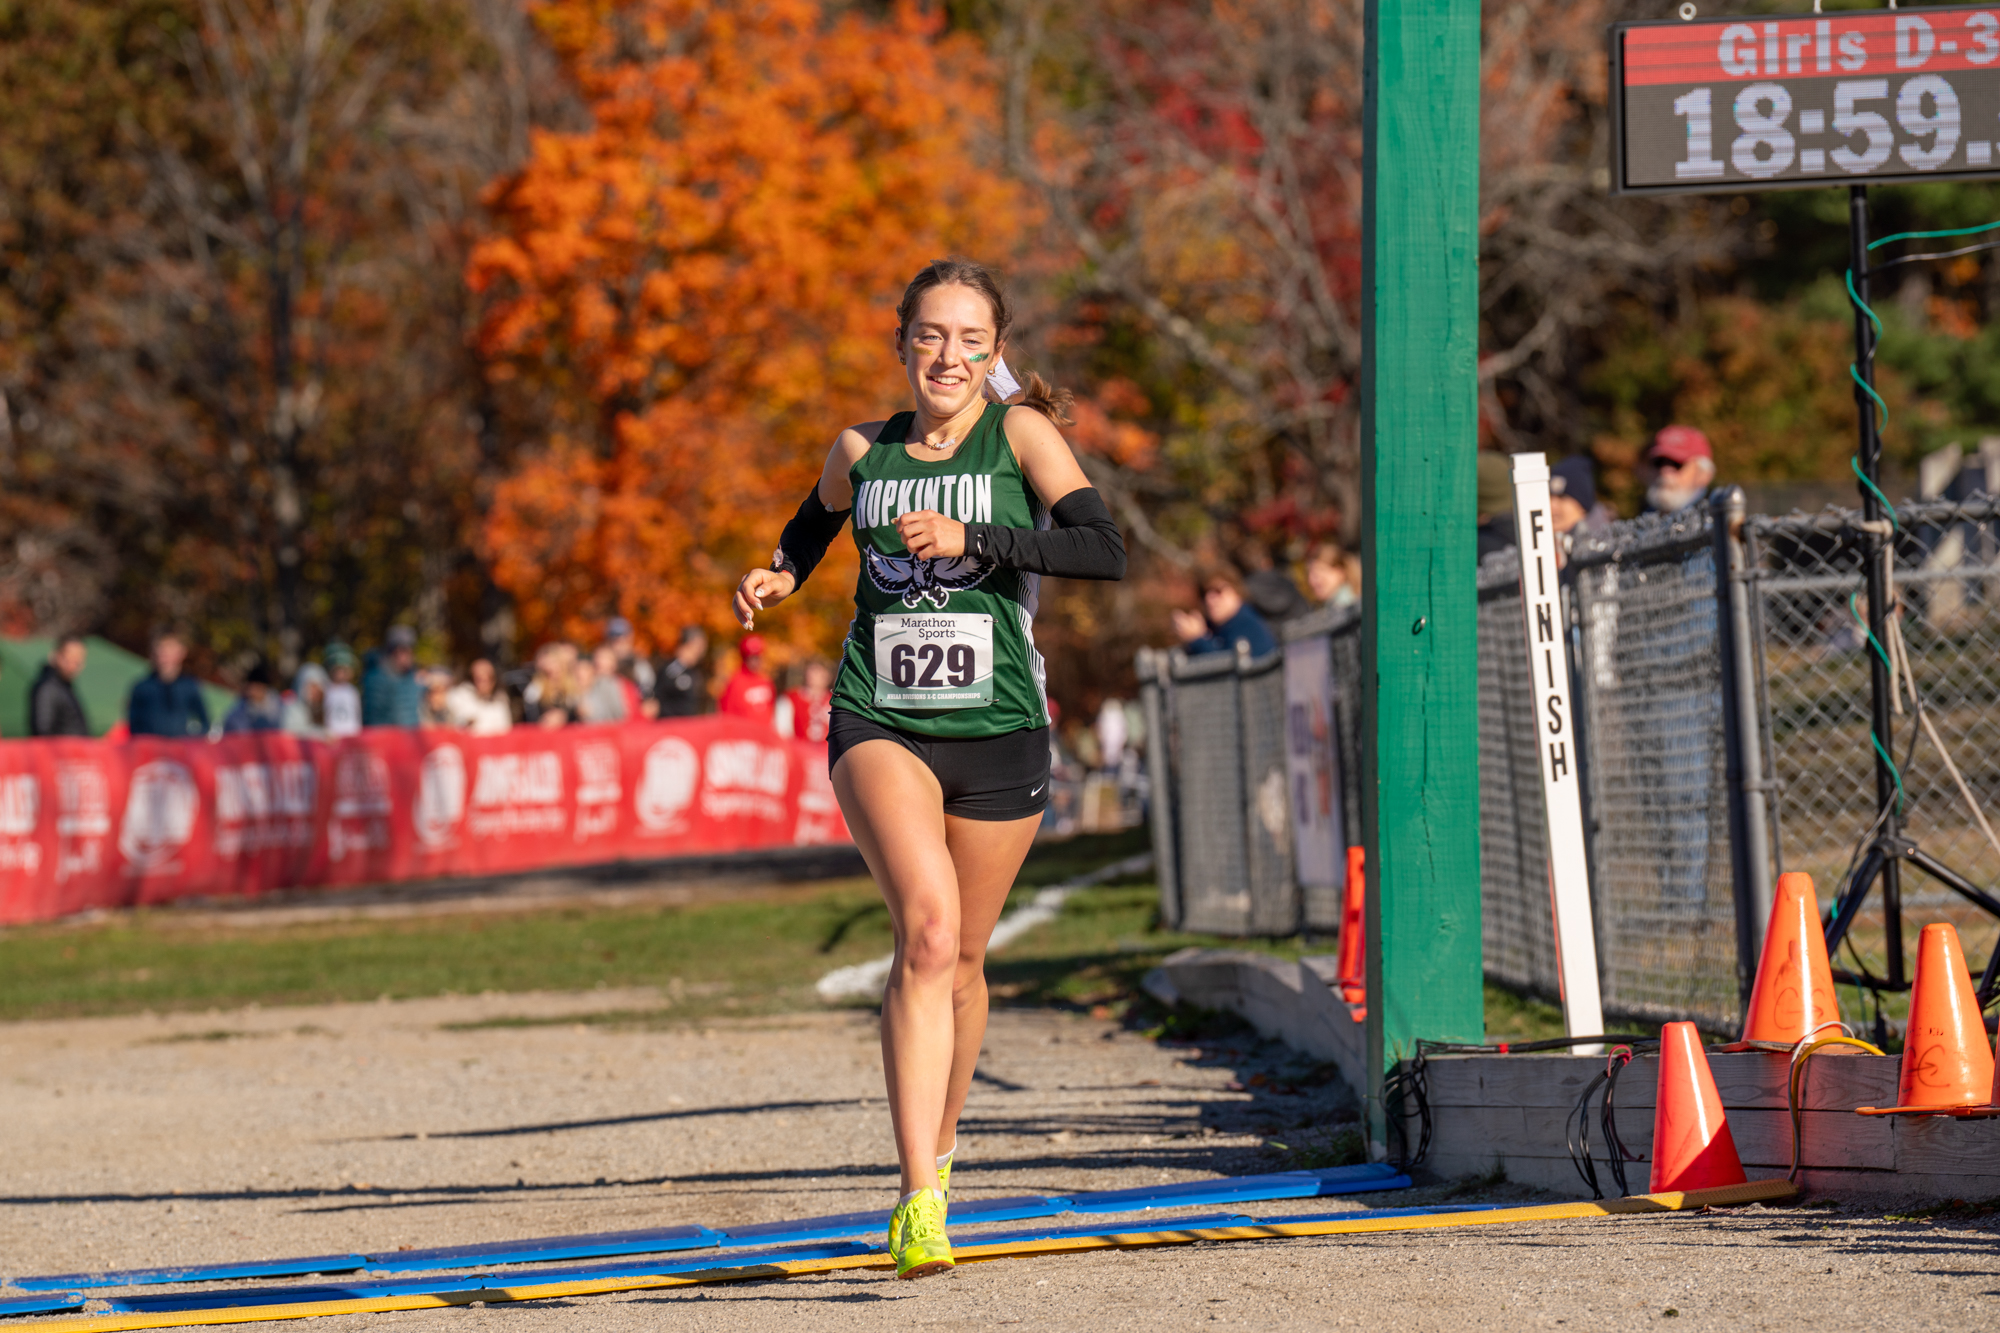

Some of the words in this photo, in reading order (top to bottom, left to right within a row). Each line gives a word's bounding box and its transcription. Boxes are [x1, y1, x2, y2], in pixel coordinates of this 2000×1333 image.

[1718, 20, 1869, 76] Girls
[1895, 12, 2000, 68] D-3
[1674, 74, 2000, 178] 18:59.
[856, 473, 992, 530] HOPKINTON
[901, 618, 956, 628] Marathon
[918, 628, 956, 641] Sports
[1530, 509, 1568, 782] FINISH
[891, 643, 975, 688] 629
[937, 692, 981, 700] CHAMPIONSHIPS
